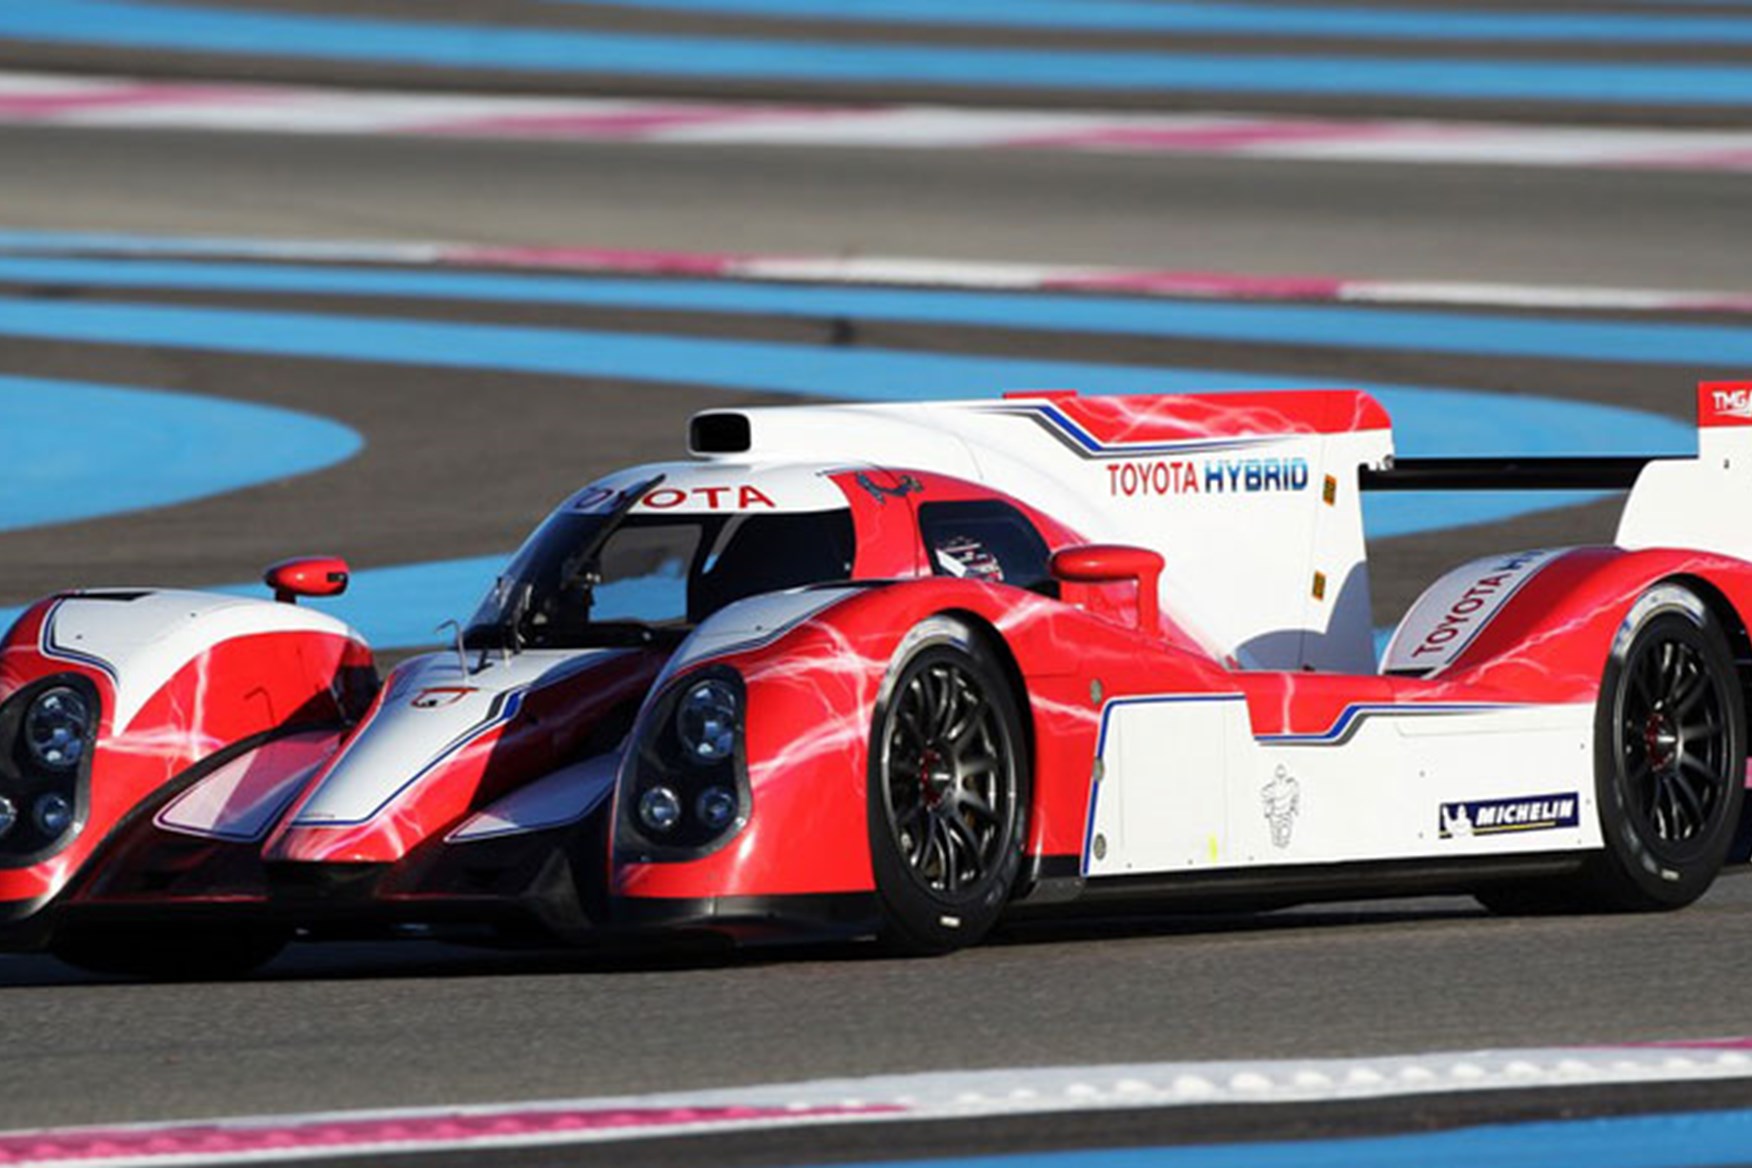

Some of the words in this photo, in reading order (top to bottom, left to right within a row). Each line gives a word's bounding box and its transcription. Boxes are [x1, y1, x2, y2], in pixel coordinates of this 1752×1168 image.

[1107, 462, 1199, 496] TOYOTA
[1204, 457, 1309, 493] HYBRID
[1411, 573, 1512, 658] TOYOTA
[1475, 799, 1574, 826] MICHELIN
